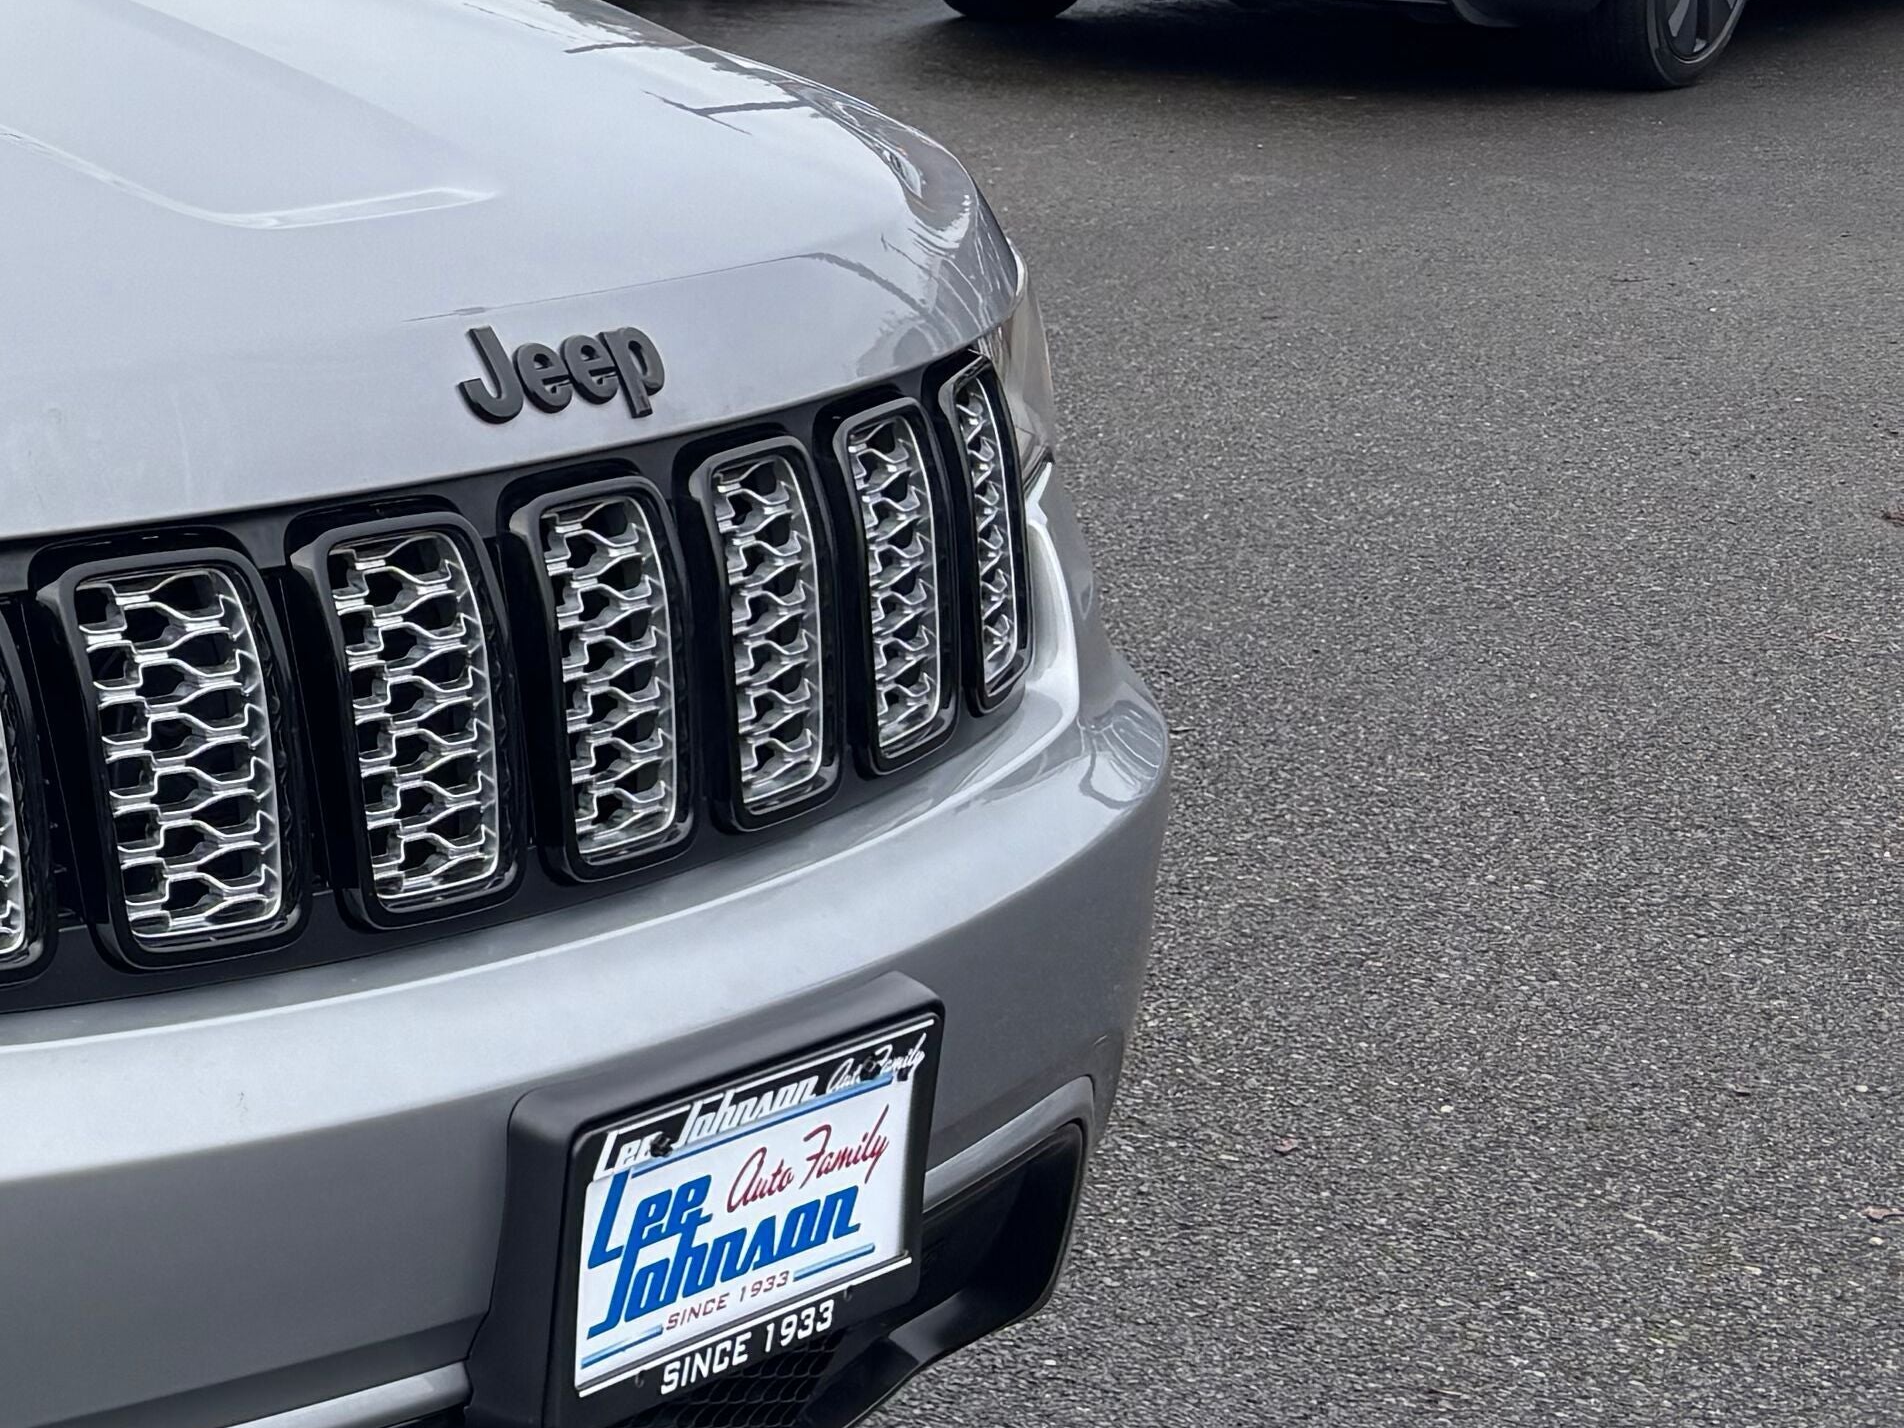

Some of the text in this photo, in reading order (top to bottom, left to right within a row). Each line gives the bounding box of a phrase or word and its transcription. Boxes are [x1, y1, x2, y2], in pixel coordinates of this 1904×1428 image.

[457, 325, 665, 425] Jeep
[673, 1074, 818, 1149] Johnson
[826, 1058, 876, 1095] Aut
[588, 1103, 890, 1269] Lee Auto Family
[586, 1184, 861, 1340] Johnson
[665, 1270, 790, 1331] SINCE 1933
[659, 1299, 835, 1395] SINCE 1933
